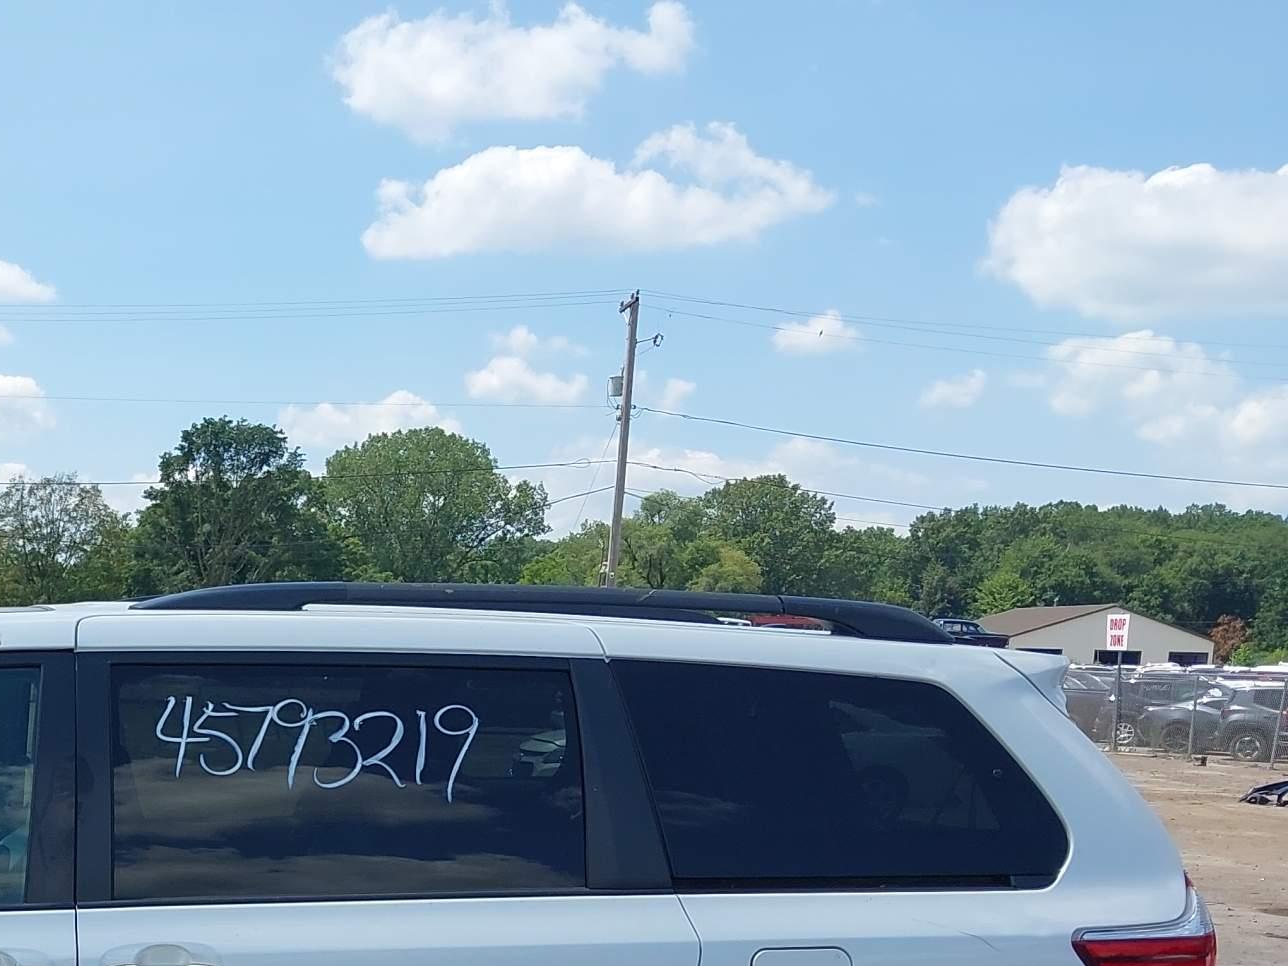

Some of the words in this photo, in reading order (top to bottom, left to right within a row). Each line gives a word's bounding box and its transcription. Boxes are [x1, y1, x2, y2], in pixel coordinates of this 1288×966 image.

[1110, 619, 1126, 630] DROP
[1110, 635, 1124, 647] ZONE
[156, 696, 479, 803] 45793219
